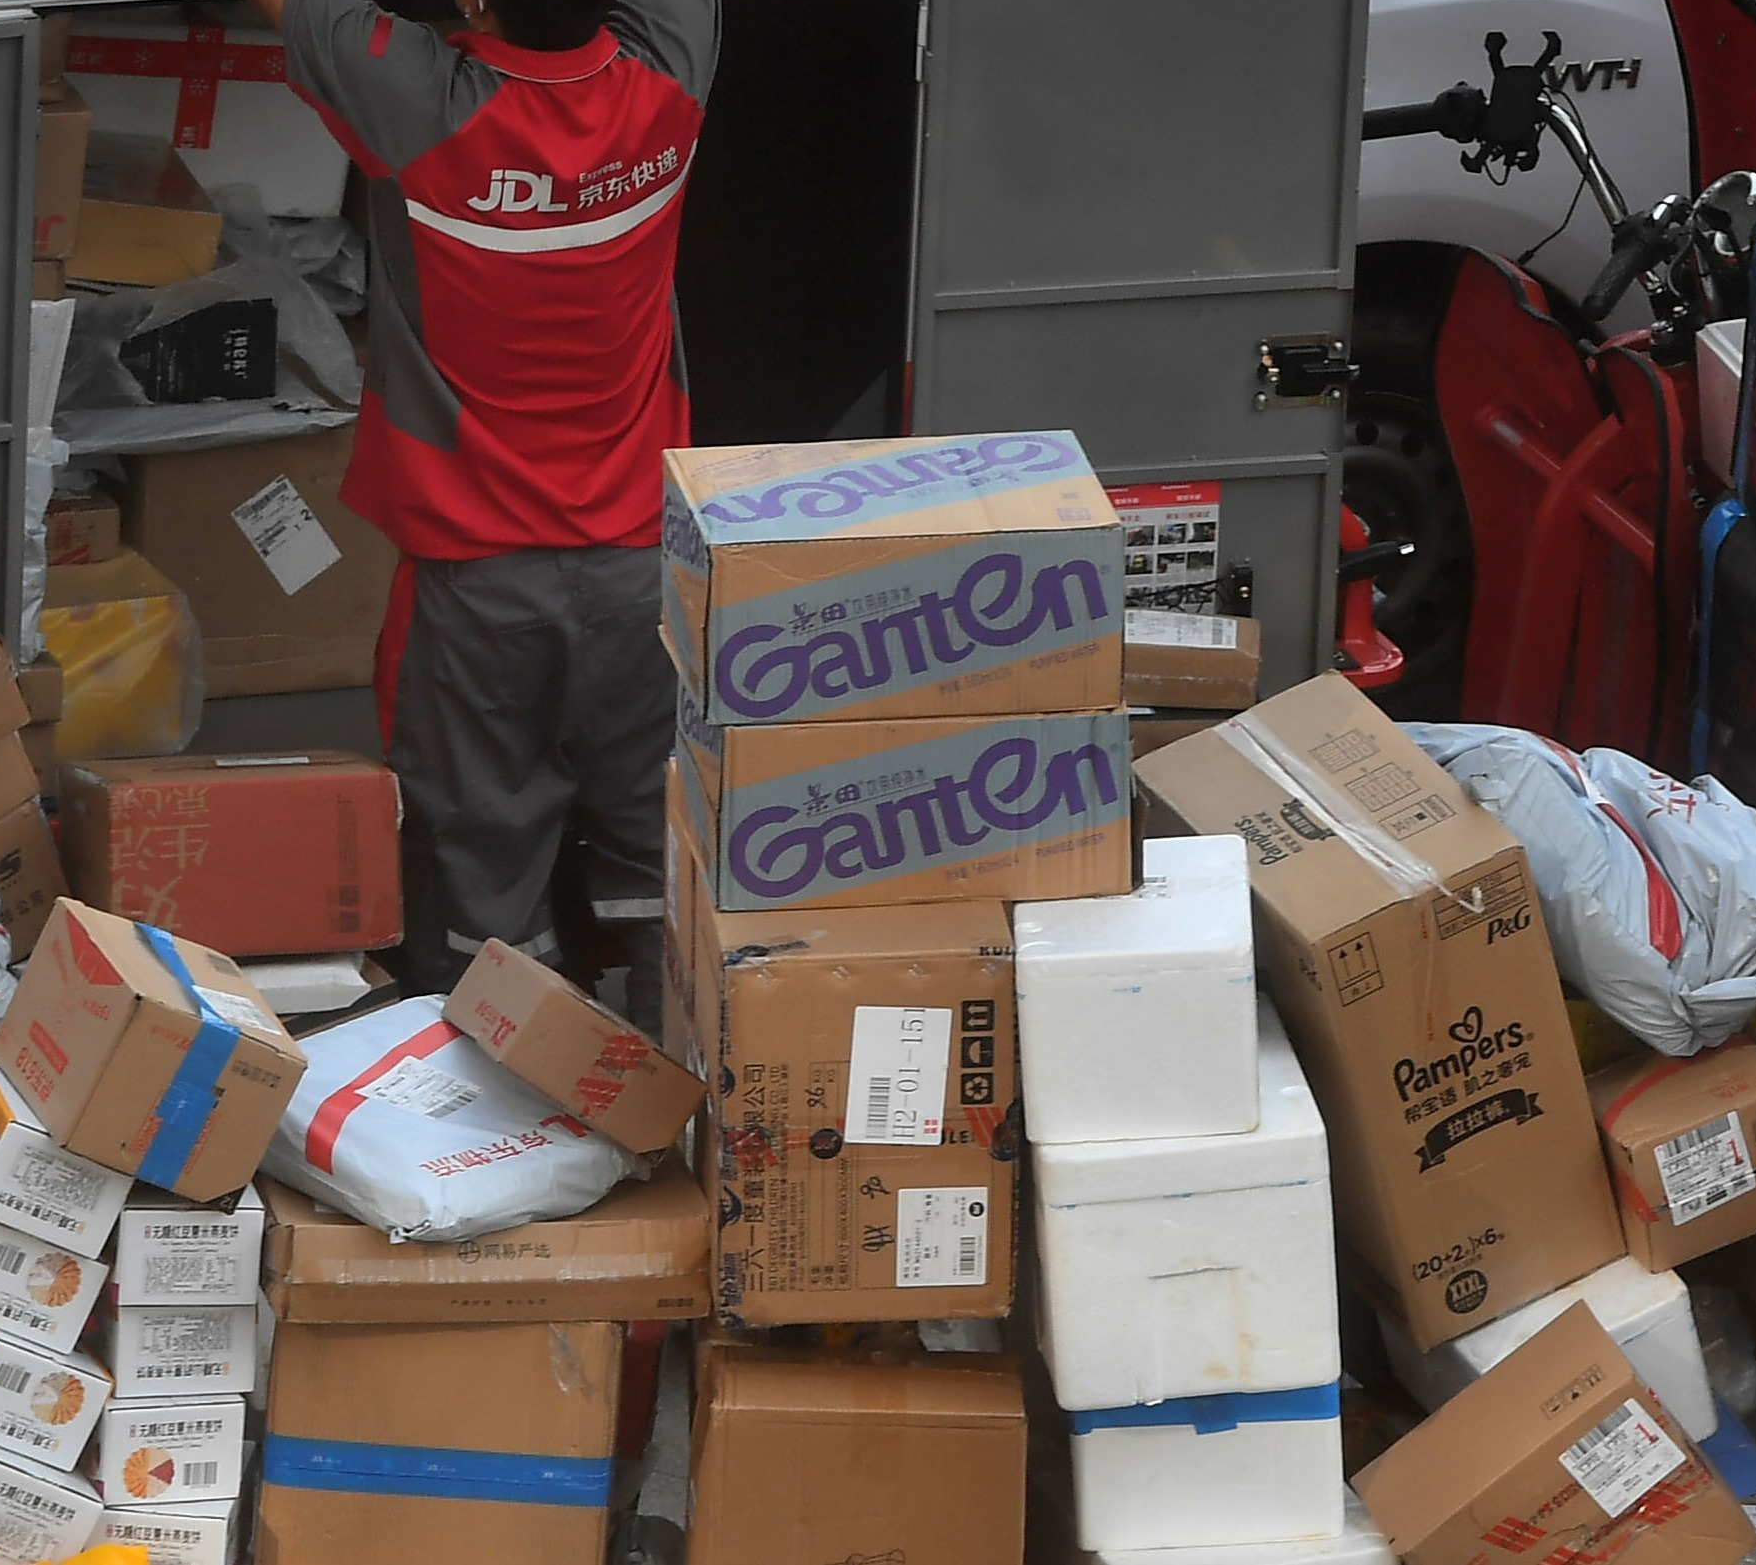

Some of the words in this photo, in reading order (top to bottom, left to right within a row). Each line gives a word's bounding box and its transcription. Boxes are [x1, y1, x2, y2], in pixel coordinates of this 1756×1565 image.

[466, 168, 570, 213] JDL
[578, 159, 624, 184] Express
[577, 144, 680, 209] 京东快递
[715, 552, 1110, 719] Ganten
[727, 737, 1118, 898] Ganten
[1486, 906, 1533, 947] P&G
[1394, 1020, 1528, 1103] Pampers
[1403, 1082, 1459, 1126] 帮宝适
[419, 1121, 554, 1177] 京东物流
[743, 1062, 768, 1294] 三六一度童装限公司
